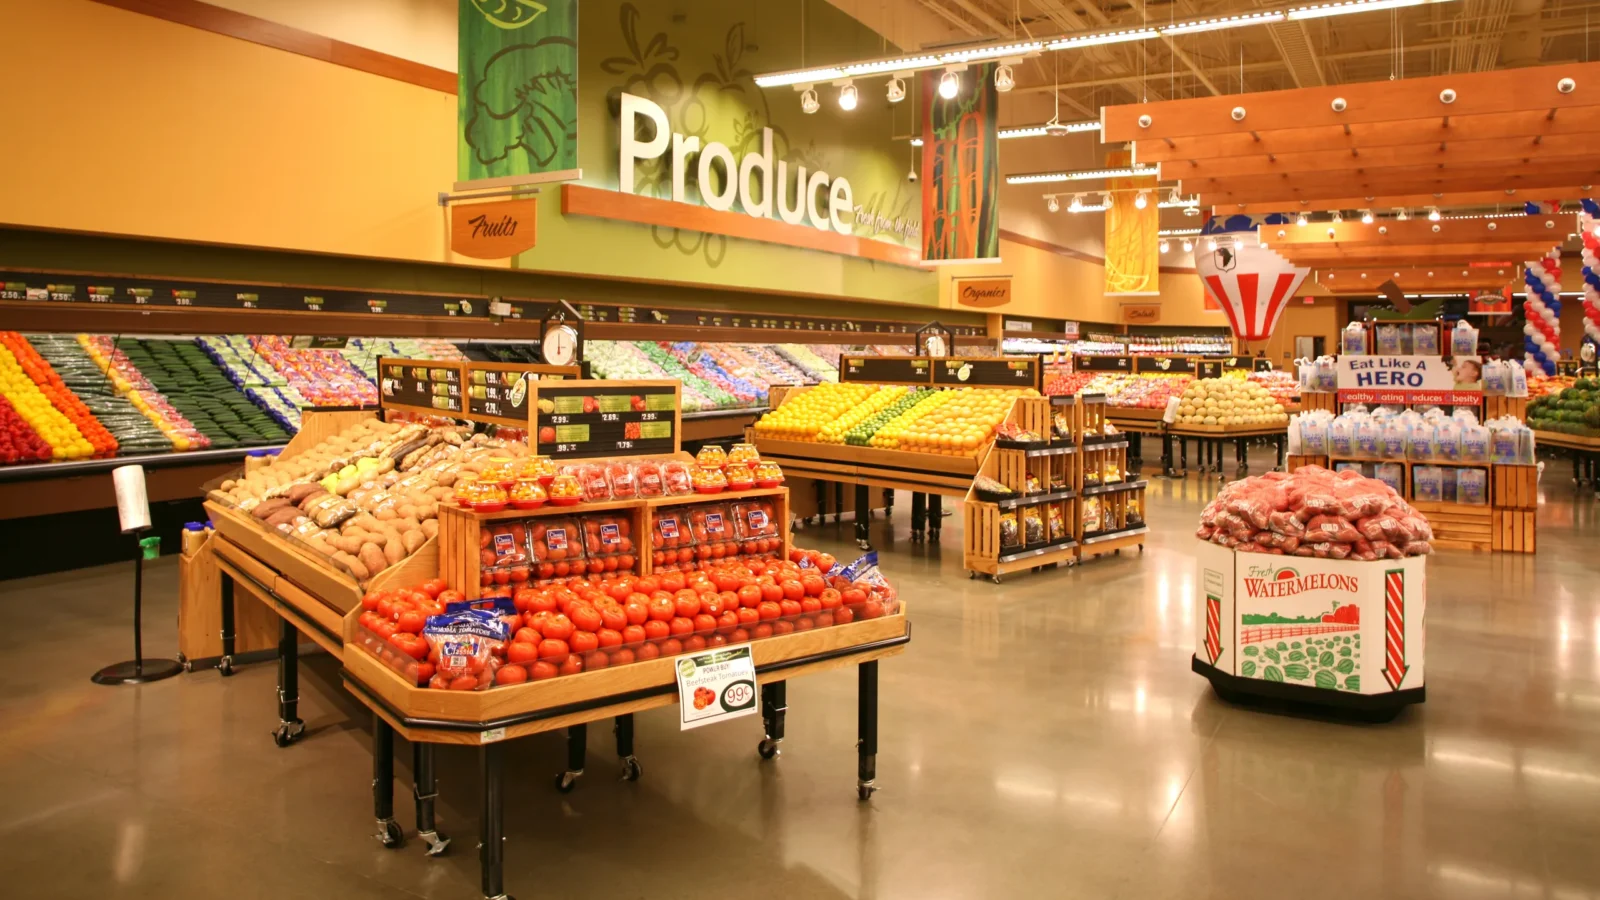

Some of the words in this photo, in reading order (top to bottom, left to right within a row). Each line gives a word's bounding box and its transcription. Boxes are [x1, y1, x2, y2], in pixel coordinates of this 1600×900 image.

[618, 92, 854, 235] Produce
[468, 214, 518, 239] Fruits
[962, 286, 1006, 301] Organics
[1349, 359, 1374, 370] Eat
[1380, 358, 1410, 368] Like
[1416, 360, 1427, 370] A
[1357, 371, 1424, 387] HERO
[1248, 563, 1274, 577] Fresh
[1243, 573, 1359, 598] WATERMELONS
[702, 666, 720, 674] POWER
[686, 674, 717, 687] Beefsteak
[718, 670, 749, 681] Tomatoes
